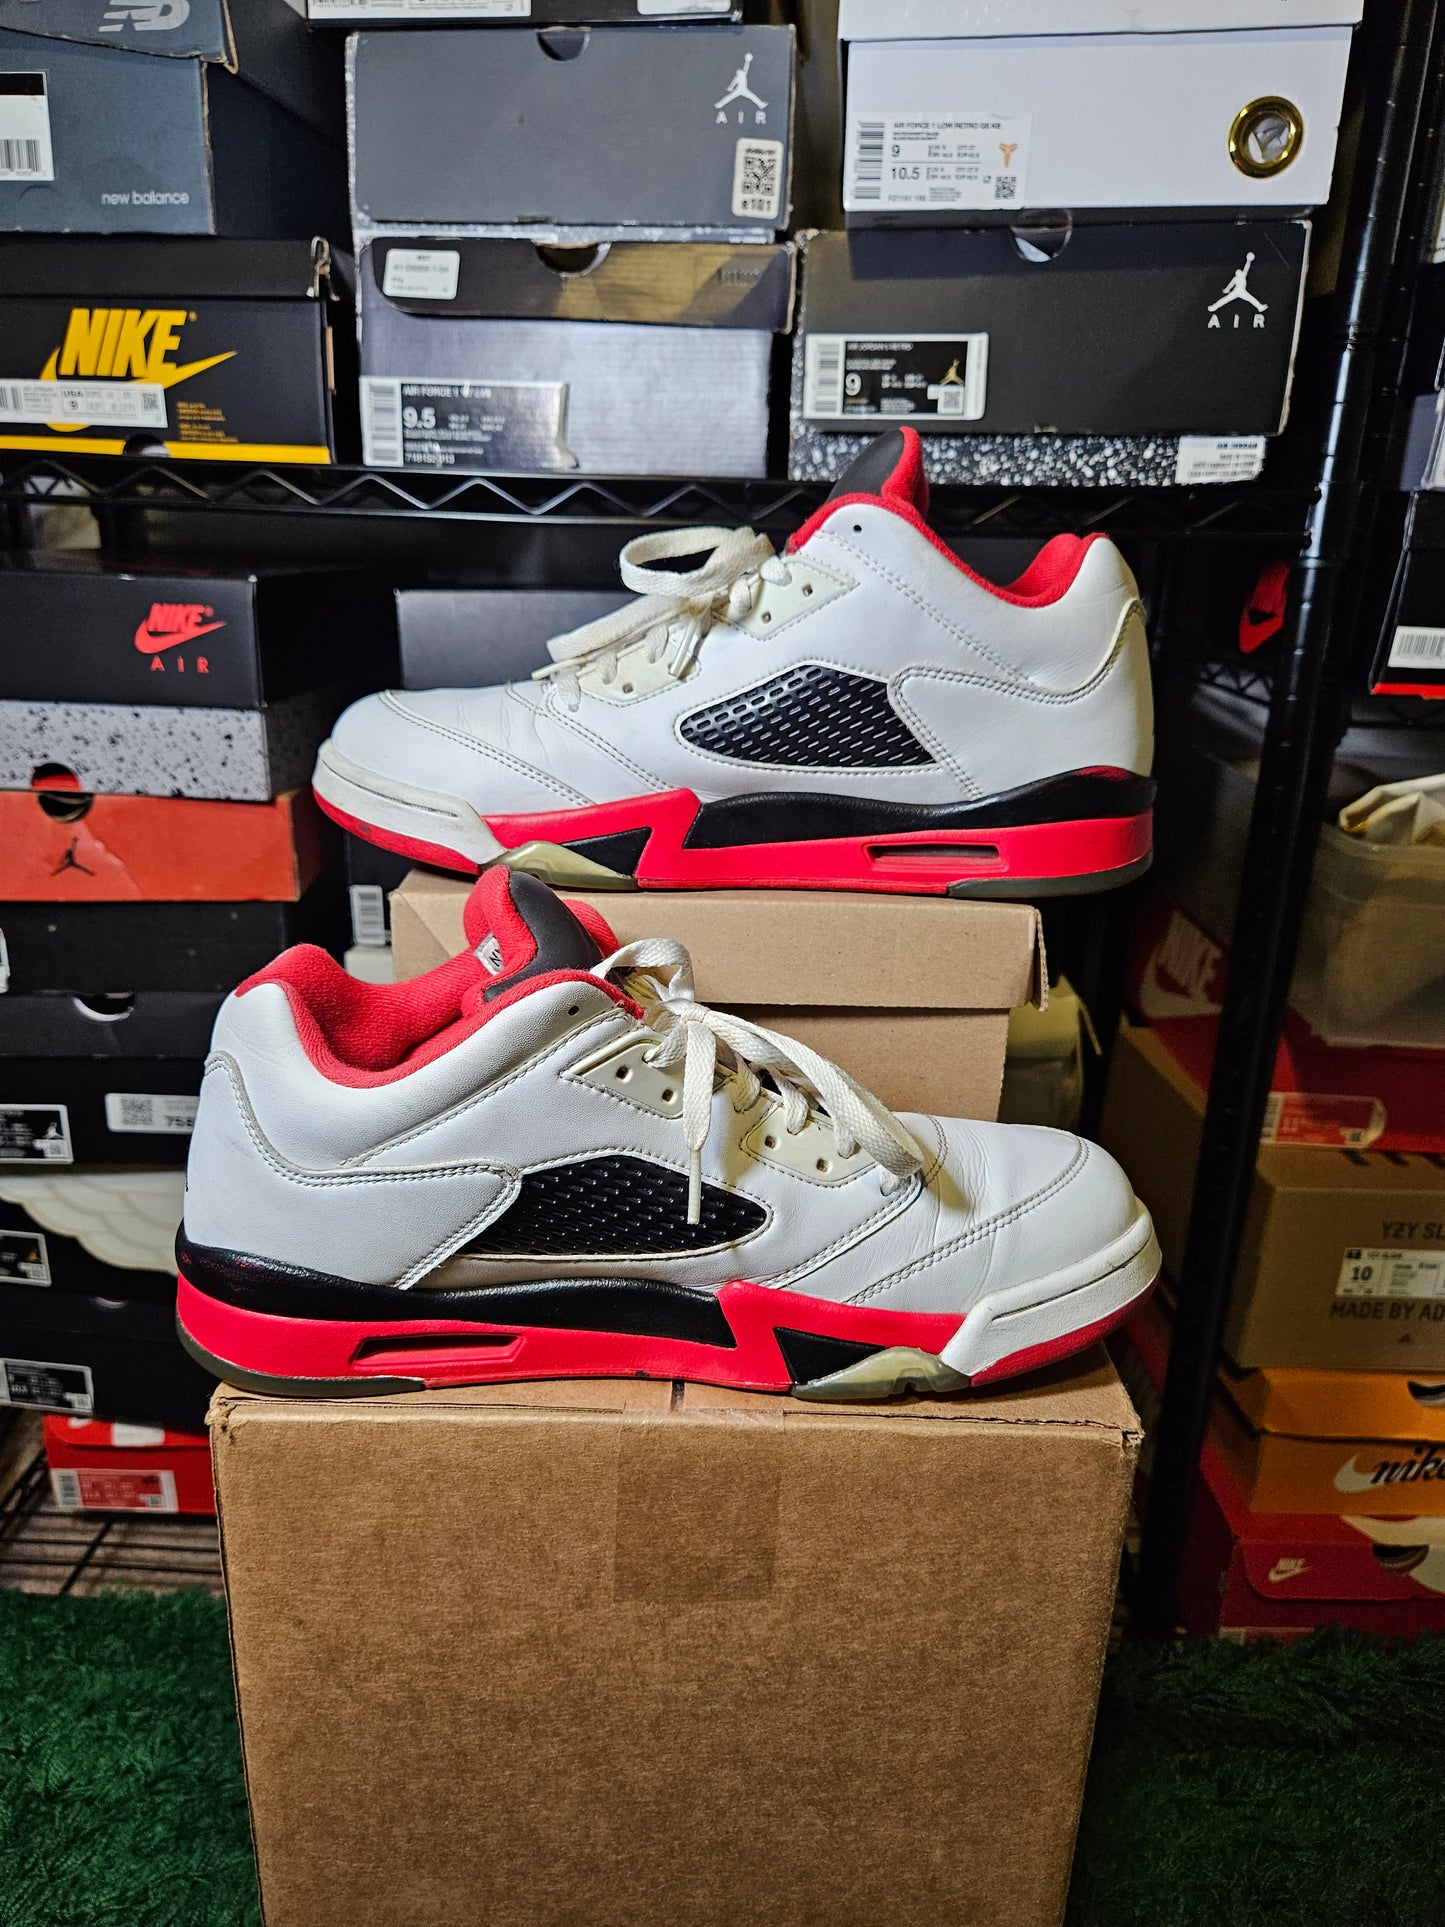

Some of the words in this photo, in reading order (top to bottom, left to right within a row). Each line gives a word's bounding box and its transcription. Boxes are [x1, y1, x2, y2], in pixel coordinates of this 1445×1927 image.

[715, 110, 767, 125] AIR
[891, 145, 901, 158] 9
[891, 167, 921, 180] 10.5
[101, 193, 130, 205] new
[132, 191, 190, 205] balance
[1207, 313, 1265, 329] AIR
[59, 308, 188, 378] NIKE
[845, 372, 862, 396] 9
[402, 406, 437, 429] 9.5
[148, 603, 206, 633] NIKE
[150, 655, 209, 673] AIR
[1382, 1220, 1420, 1239] YZY
[1350, 1266, 1373, 1281] 10
[1330, 1301, 1385, 1319] MADE
[1388, 1302, 1416, 1319] BY
